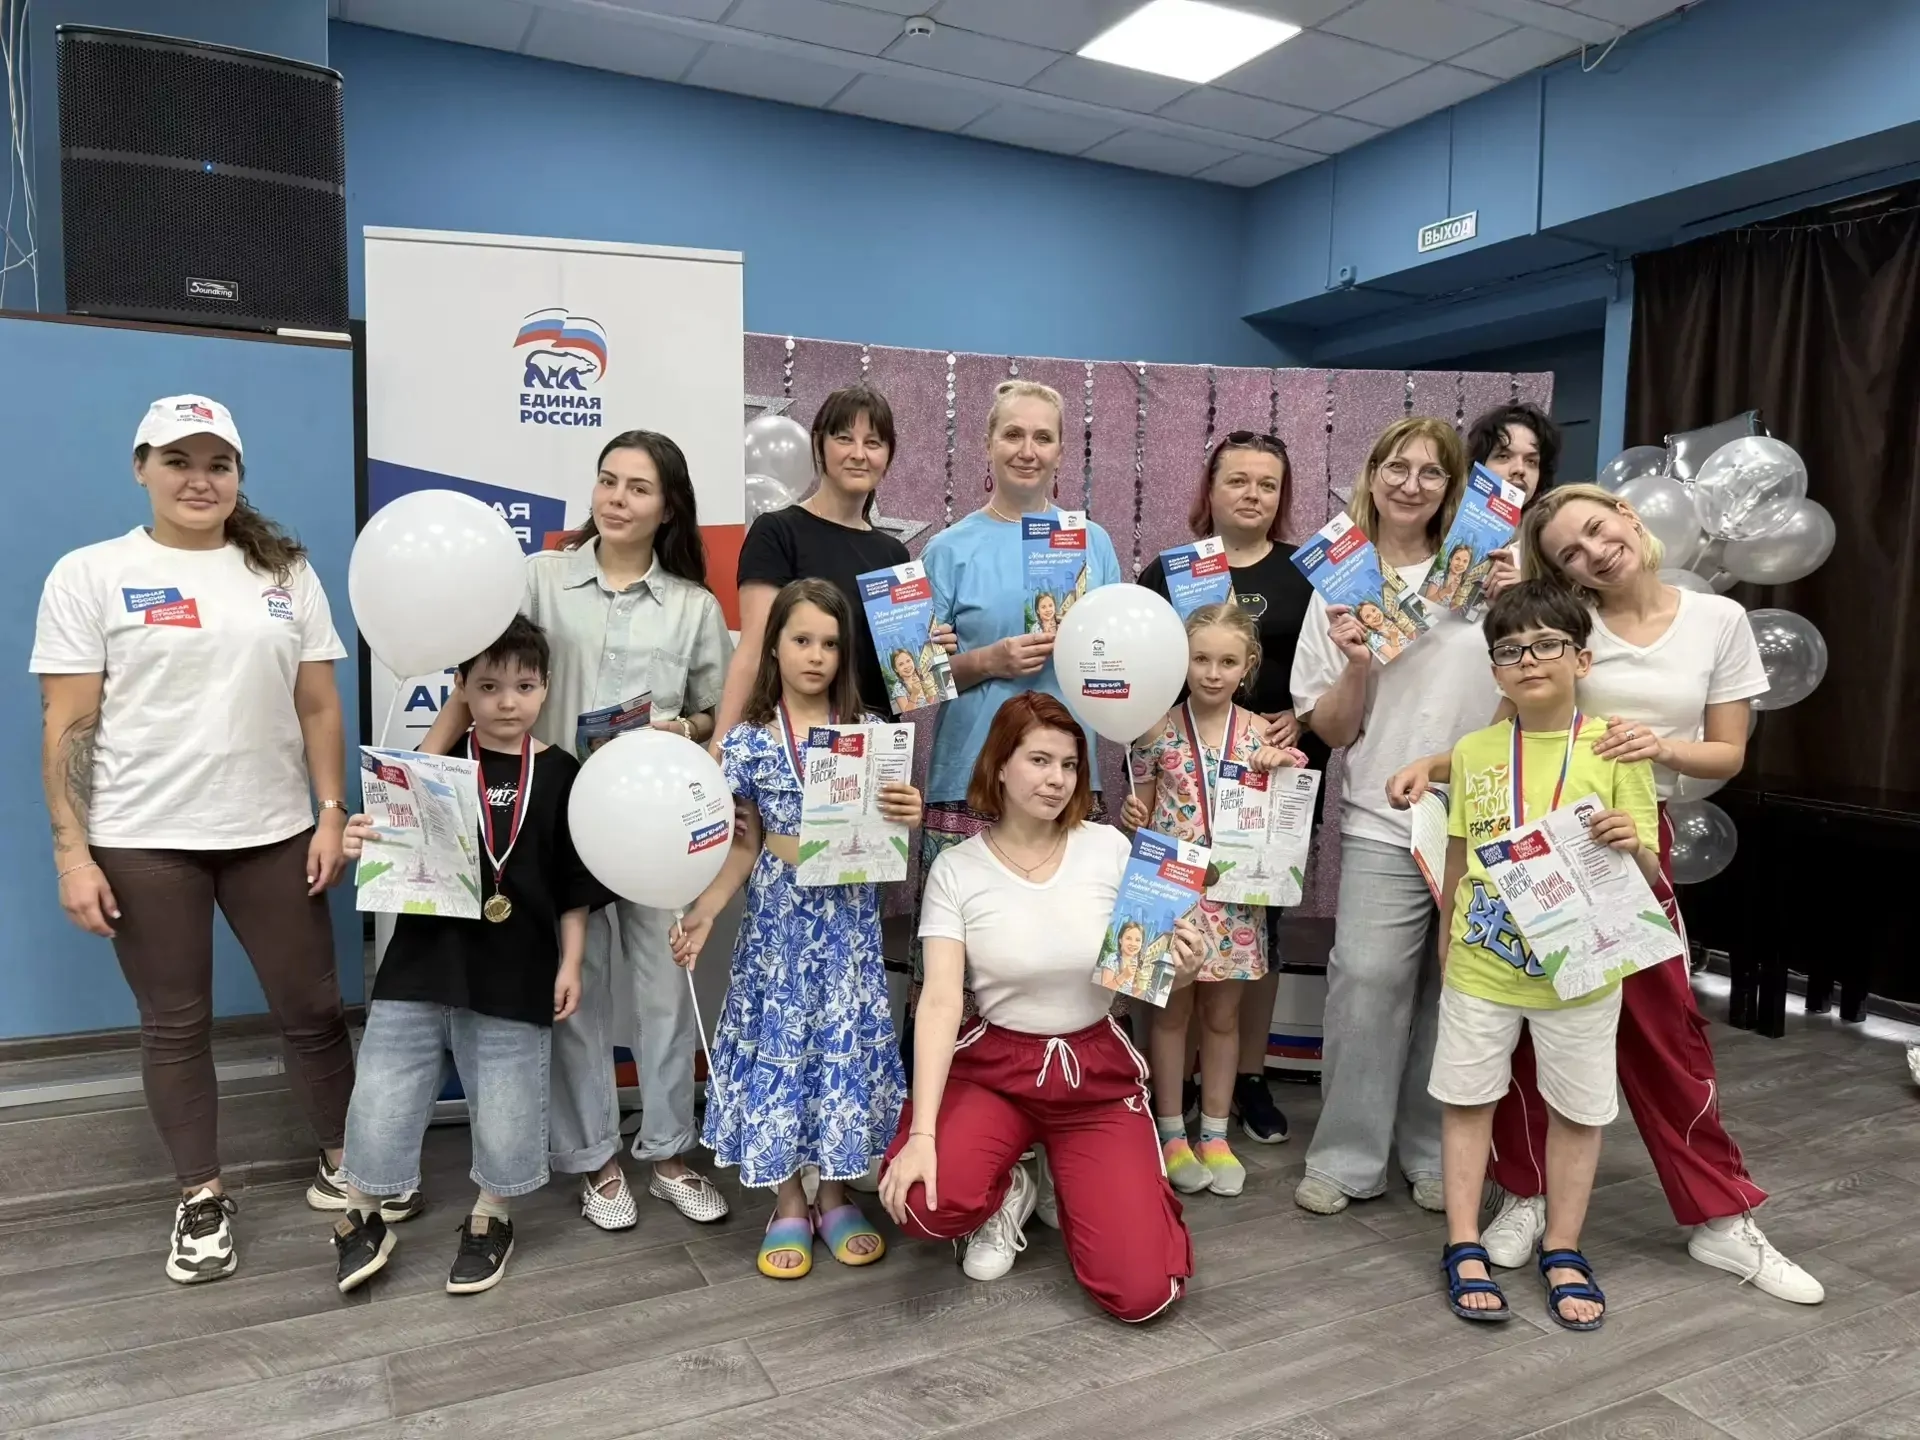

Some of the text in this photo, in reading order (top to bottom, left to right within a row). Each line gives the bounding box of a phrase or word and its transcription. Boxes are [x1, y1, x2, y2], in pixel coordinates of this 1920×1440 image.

[1425, 217, 1472, 246] ВЫХОД
[520, 394, 601, 409] ЕДИНАЯ
[520, 410, 602, 427] РОССИЯ
[810, 756, 838, 773] ЕДИНАЯ
[810, 768, 836, 785] РОССИЯ
[830, 774, 858, 791] РОДИНА
[365, 782, 387, 793] ЕДИНАЯ
[1221, 787, 1245, 800] ЕДИНАЯ
[365, 792, 389, 804] РОССИЯ
[830, 788, 861, 804] ТАЛАНТОВ
[1220, 798, 1244, 810] РОССИЯ
[387, 803, 414, 817] РОДИНА
[1238, 806, 1262, 819] РОДИНА
[389, 815, 419, 828] ТАЛАНТОВ
[1238, 818, 1265, 830] ТАЛАНТОВ
[1498, 862, 1528, 891] ЕДИНАЯ
[1505, 875, 1534, 902] РОССИЯ
[1531, 870, 1565, 901] РОДИНА
[1538, 881, 1576, 912] ТАЛАНТОВ
